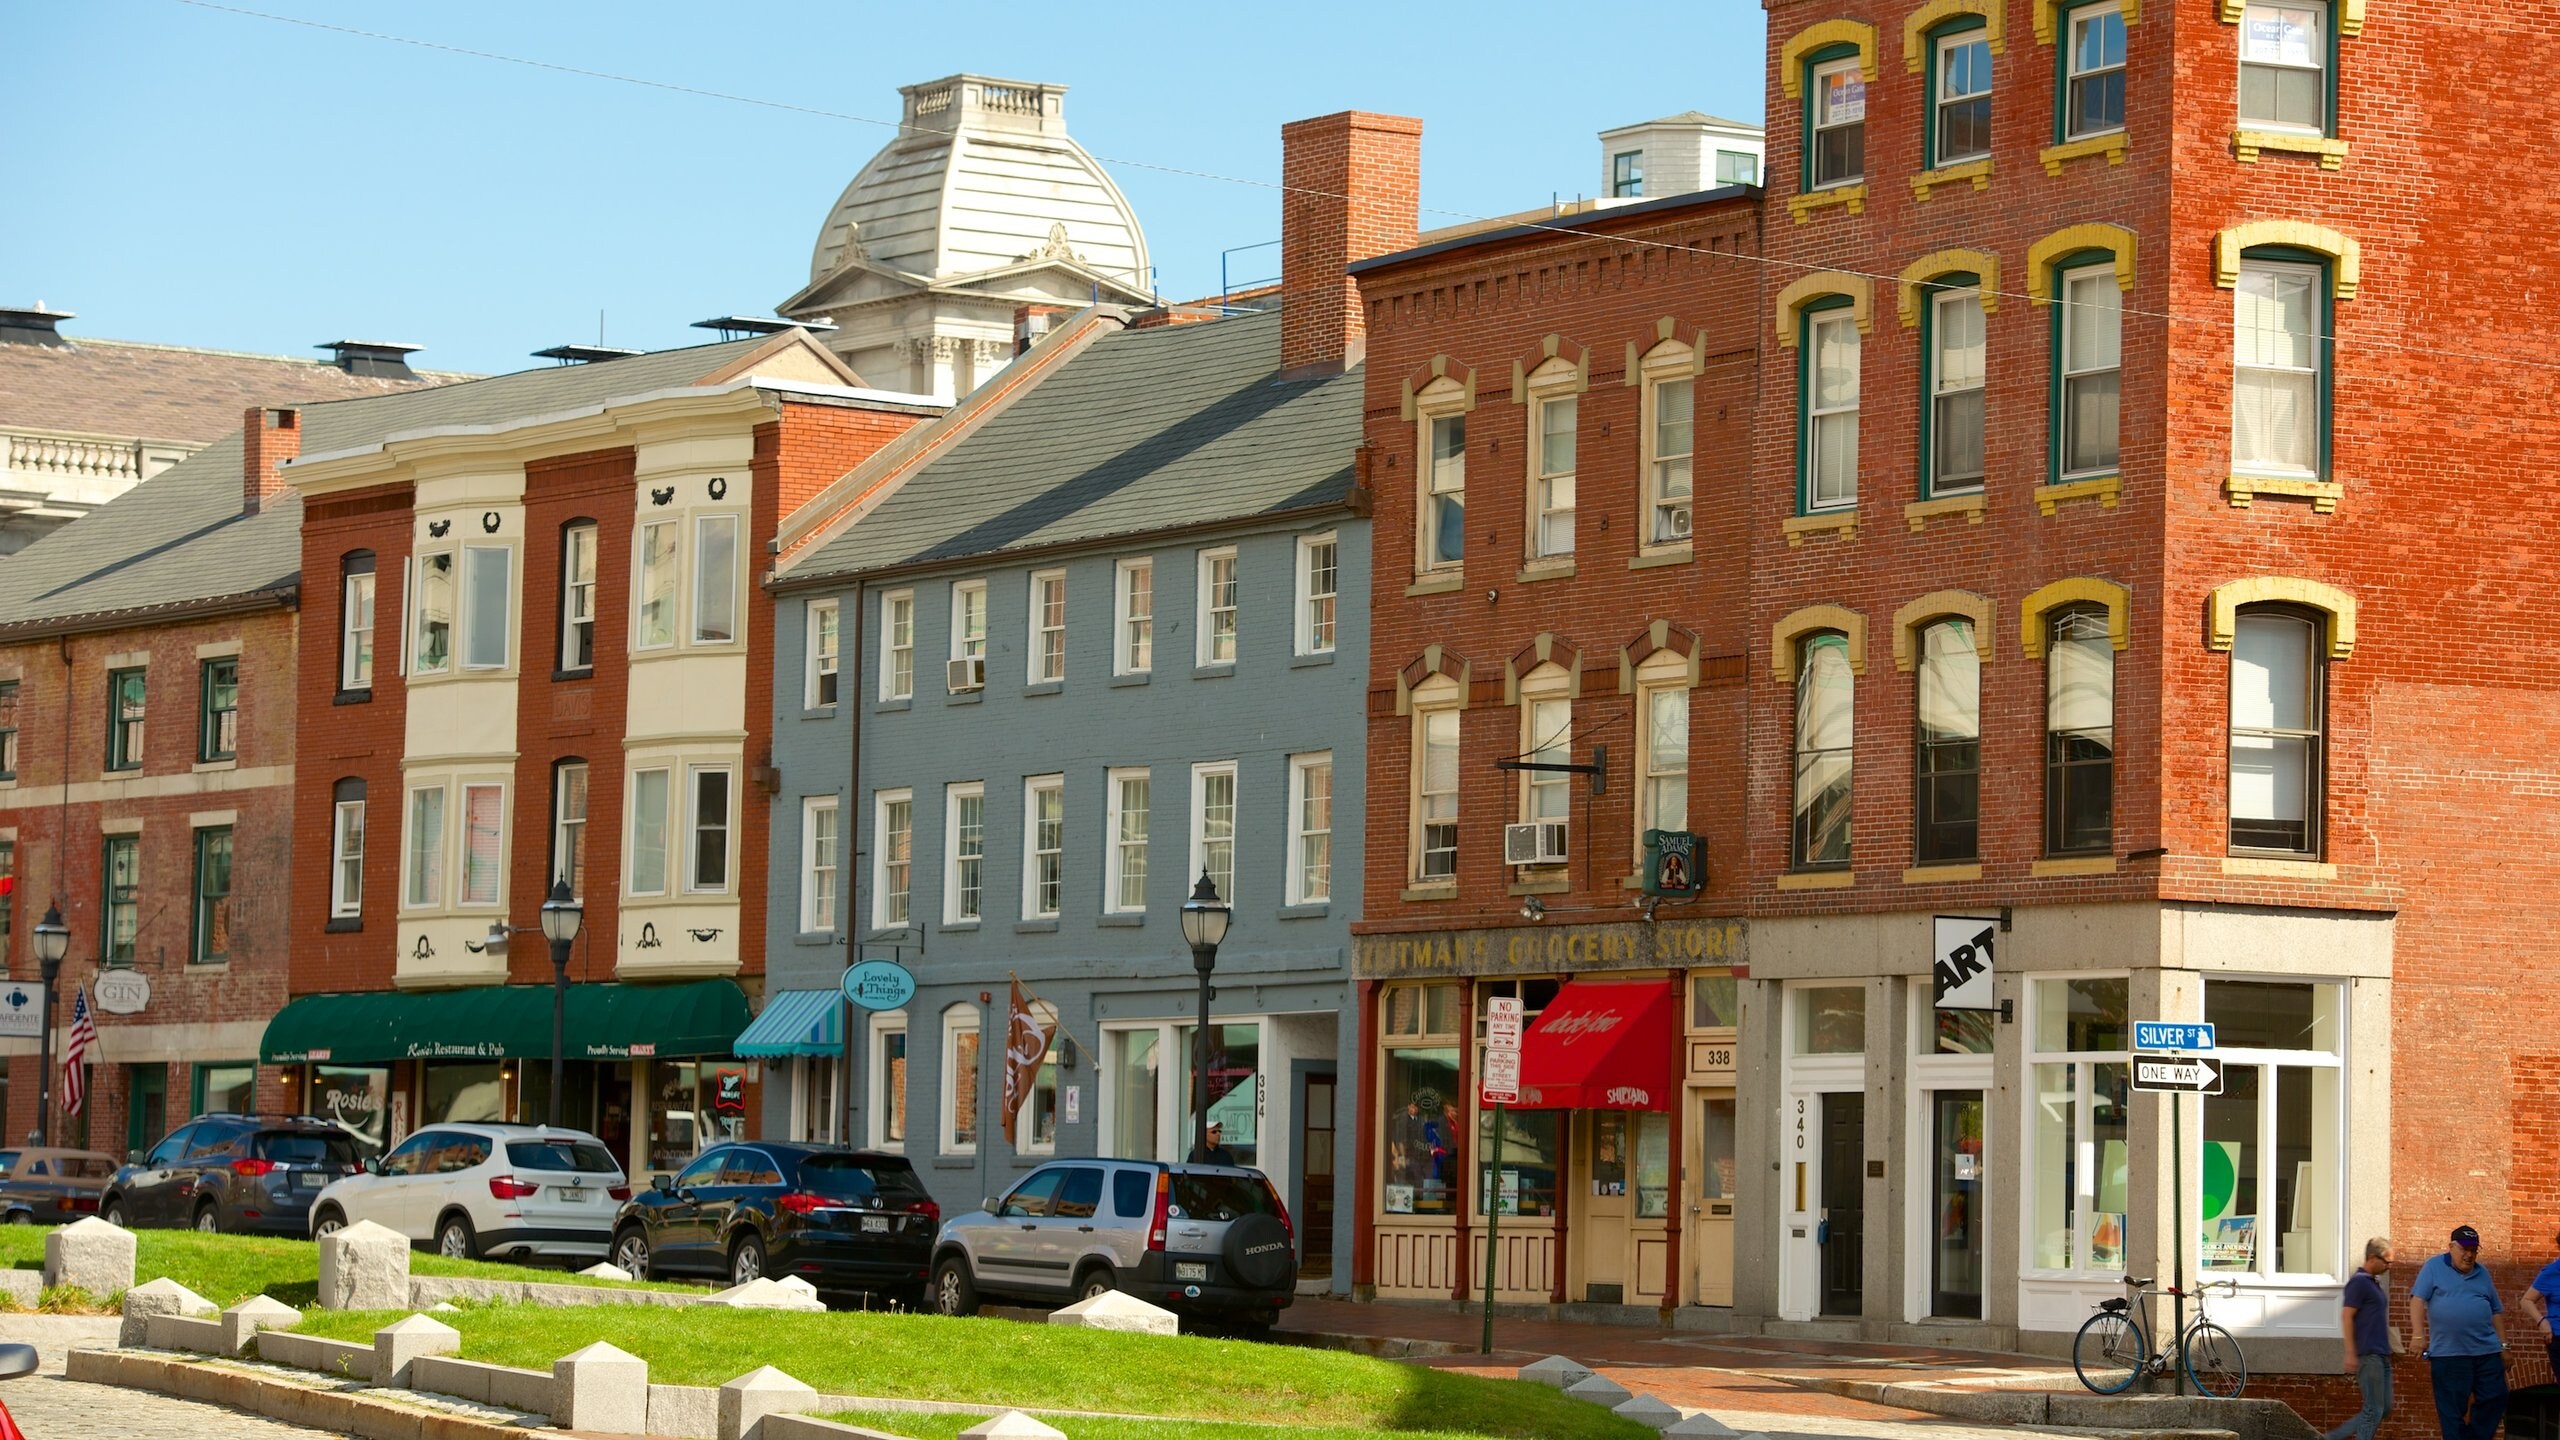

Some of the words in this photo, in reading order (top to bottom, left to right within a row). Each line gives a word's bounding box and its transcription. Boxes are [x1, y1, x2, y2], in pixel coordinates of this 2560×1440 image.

[2253, 23, 2280, 33] Ocean
[1659, 834, 1692, 846] SAMUEL
[1660, 843, 1689, 855] ADAMS
[1508, 933, 1635, 965] GROCERY
[1655, 926, 1742, 960] STORE
[1935, 926, 1993, 1003] ART
[863, 971, 900, 988] Lovely
[103, 985, 142, 1000] GIN
[864, 982, 906, 1002] Things
[1499, 1002, 1512, 1012] NO
[0, 1013, 40, 1022] ARDENTE
[1491, 1012, 1519, 1023] PARKING
[2140, 1026, 2185, 1045] SILVER
[2187, 1028, 2195, 1038] ST
[434, 1042, 476, 1056] Restaurant
[478, 1041, 486, 1056] &
[489, 1042, 505, 1056] Pub
[609, 1044, 629, 1058] Serving
[1708, 1050, 1730, 1065] 338
[2142, 1065, 2167, 1080] ONE
[2174, 1067, 2200, 1081] WAY
[1607, 1087, 1649, 1106] SHIPYARD
[1796, 1099, 1805, 1149] 340
[1245, 1242, 1285, 1256] HONDA
